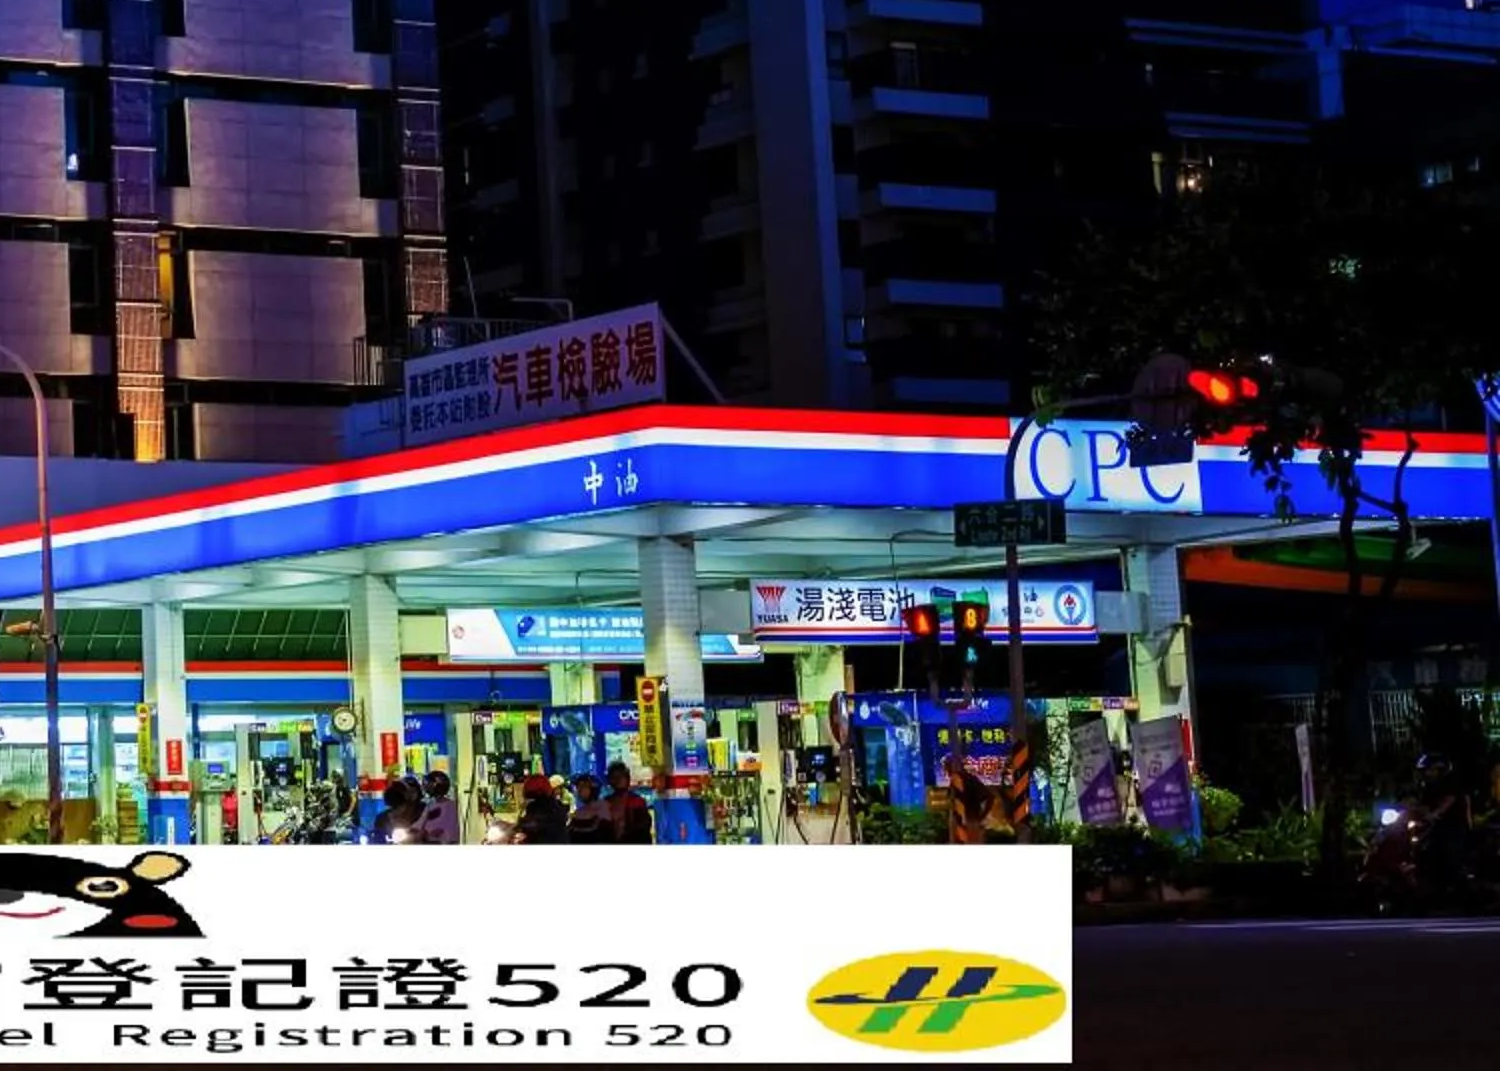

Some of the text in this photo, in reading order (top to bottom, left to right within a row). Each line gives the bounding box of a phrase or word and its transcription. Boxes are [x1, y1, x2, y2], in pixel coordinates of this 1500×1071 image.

[493, 321, 657, 414] 汽車檢驗場
[582, 459, 640, 506] 中油
[757, 614, 789, 624] YUASA
[795, 585, 915, 622] 湯淺電池
